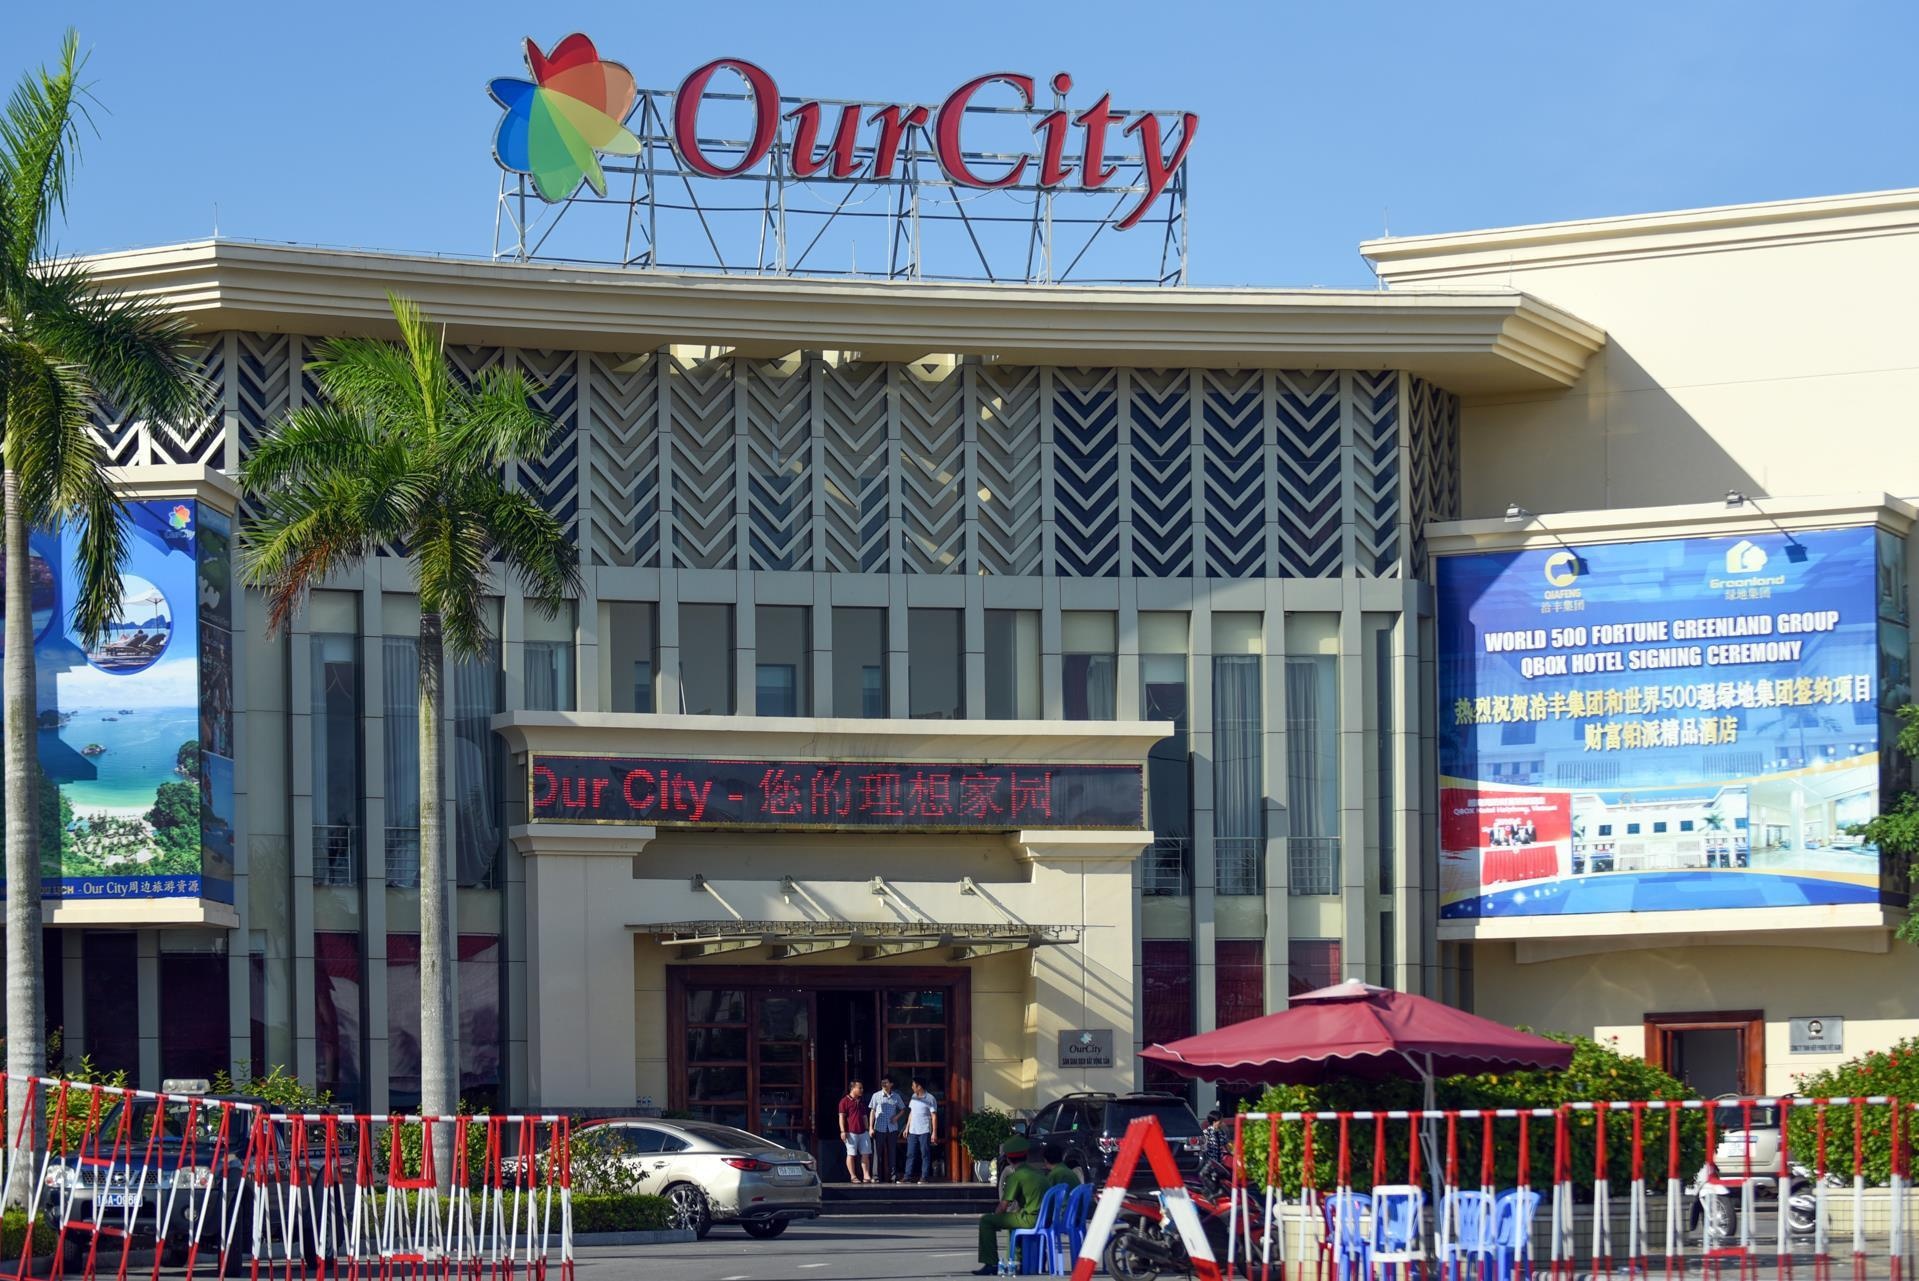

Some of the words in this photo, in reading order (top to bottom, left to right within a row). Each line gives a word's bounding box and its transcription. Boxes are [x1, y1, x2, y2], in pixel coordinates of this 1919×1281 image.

[672, 56, 1200, 232] OurCity
[1484, 629, 1546, 652] WORLD
[1551, 627, 1587, 648] 500
[1591, 620, 1669, 645] FORTUNE
[1672, 614, 1773, 640] GREENLAND
[1776, 610, 1839, 634] GROUP
[1520, 655, 1567, 679] QBOX
[1571, 652, 1624, 674] HOTEL
[1628, 646, 1702, 670] SIGNING
[1706, 640, 1802, 665] CEREMONY
[623, 769, 713, 822] City
[758, 769, 1052, 819] 您的理想家园
[83, 882, 104, 895] Our
[106, 881, 128, 897] City
